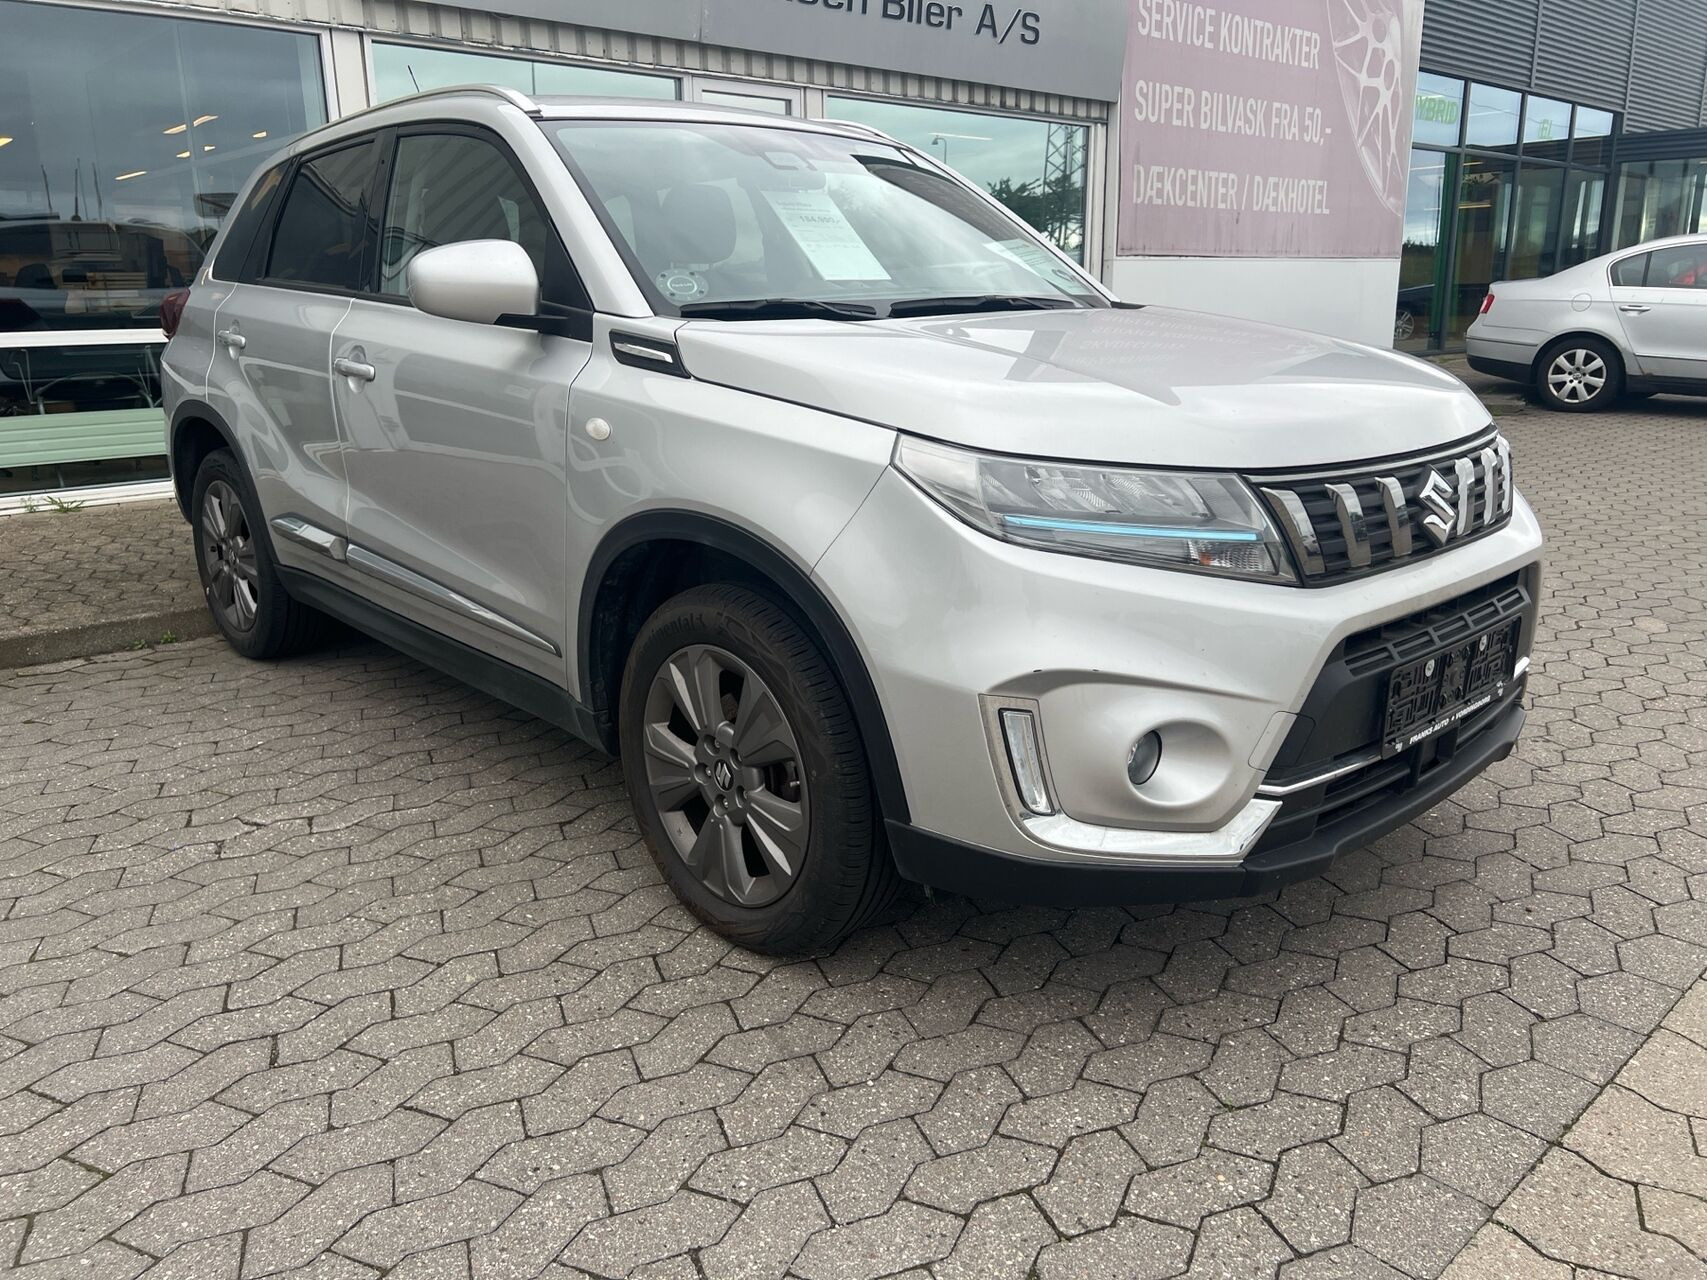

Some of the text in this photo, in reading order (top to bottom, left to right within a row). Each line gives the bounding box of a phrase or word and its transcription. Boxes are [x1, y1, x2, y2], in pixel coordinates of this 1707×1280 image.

[881, 0, 1041, 46] Biler A/S
[1137, 0, 1321, 70] SERVICE KONTRAKTER
[1134, 79, 1332, 146] SUPER BILVASK FRA 50,-
[1132, 164, 1331, 215] DÆKCENTER / DÆKHOTEL
[1409, 726, 1433, 745] FRANKS
[1433, 718, 1450, 733] AUTO
